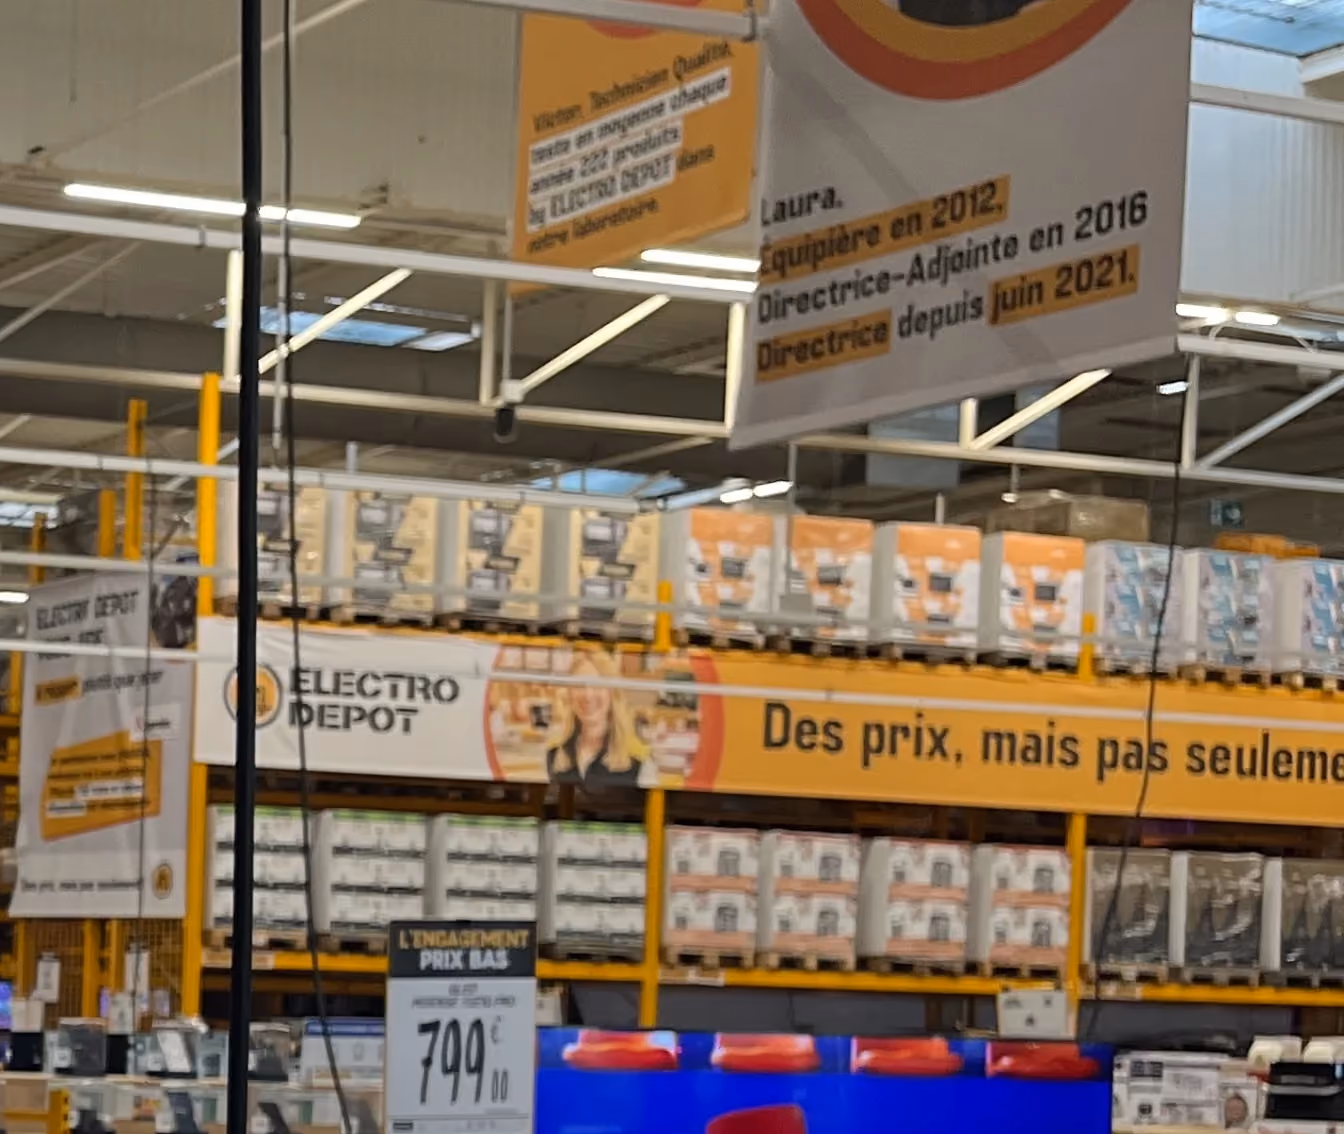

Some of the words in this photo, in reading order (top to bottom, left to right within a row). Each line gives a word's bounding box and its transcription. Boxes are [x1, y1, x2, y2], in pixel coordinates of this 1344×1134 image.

[890, 207, 923, 238] en
[757, 234, 1019, 325] Directrice-Adjointe
[1029, 221, 1063, 253] en
[1074, 190, 1149, 241] 2016
[757, 315, 889, 372] Directrice
[897, 291, 985, 341] depuis
[991, 274, 1045, 326] juin
[288, 666, 460, 704] ELECTRO
[288, 700, 419, 735] DEPOT
[762, 700, 845, 753] Des
[861, 712, 965, 770] prix,
[981, 720, 1081, 768] mais
[1097, 737, 1170, 784] pas
[419, 950, 464, 971] PRIX
[469, 950, 510, 971] BAS
[418, 1017, 486, 1107] 799
